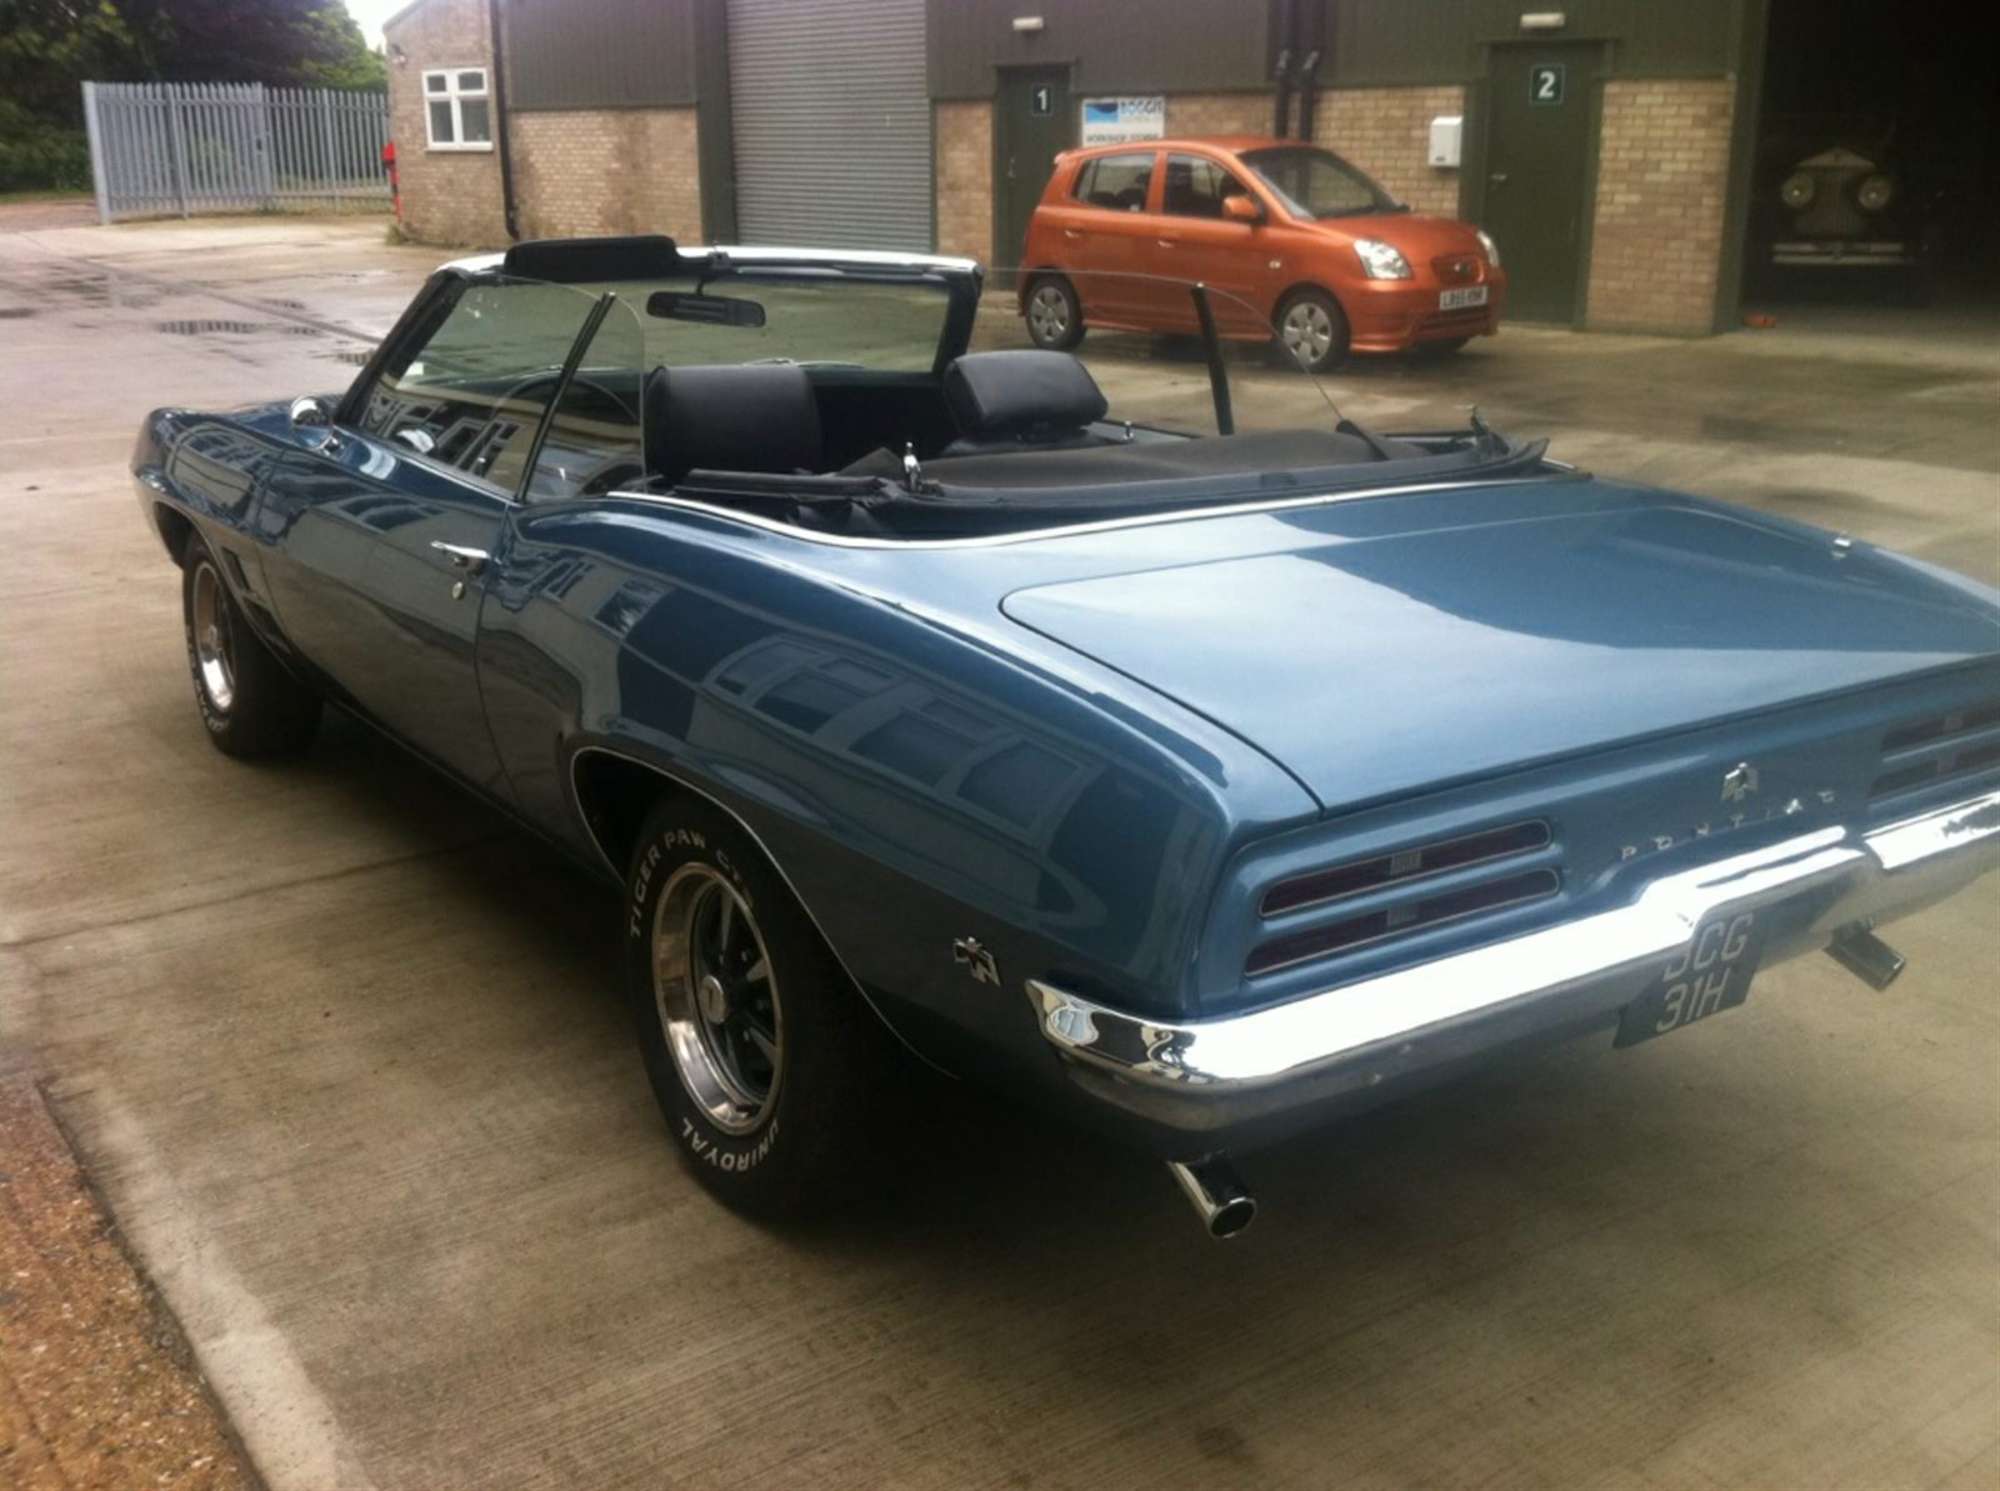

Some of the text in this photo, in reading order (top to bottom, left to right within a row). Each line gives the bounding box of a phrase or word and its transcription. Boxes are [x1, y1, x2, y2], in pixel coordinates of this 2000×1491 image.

[1037, 88, 1048, 111] 1
[1539, 70, 1555, 98] 2
[630, 828, 705, 937] TIGER PAW
[1656, 967, 1730, 1033] 31H
[682, 1117, 779, 1172] UNIROYAL
